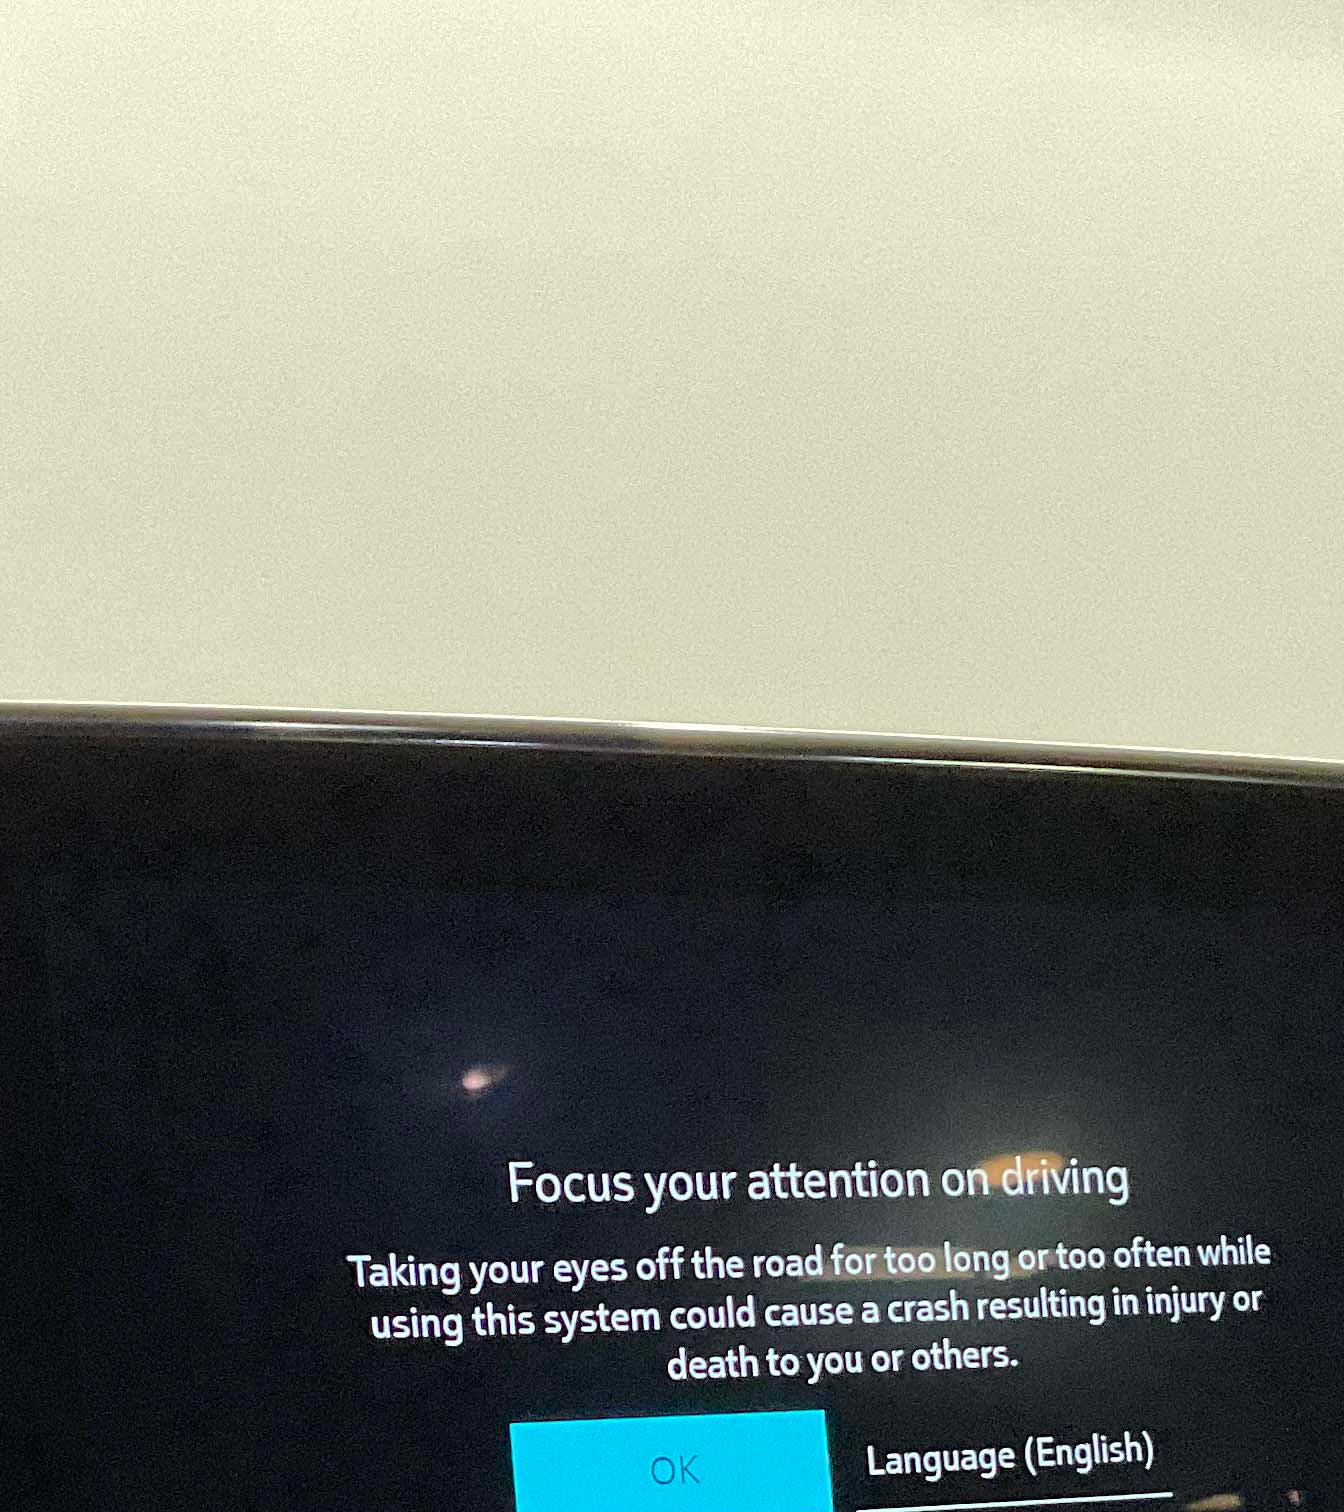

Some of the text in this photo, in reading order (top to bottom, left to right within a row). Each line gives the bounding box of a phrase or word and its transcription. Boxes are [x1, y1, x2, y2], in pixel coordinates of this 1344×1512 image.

[508, 1155, 1129, 1215] Focus your attention on driving
[345, 1234, 1271, 1296] Taking your eyes off the road for too long or too often while
[371, 1285, 1264, 1347] using this system could cause a crash resulting in injury or
[667, 1337, 1019, 1385] death to you or others.
[650, 1453, 702, 1486] OK
[867, 1430, 1154, 1483] Language (English)
